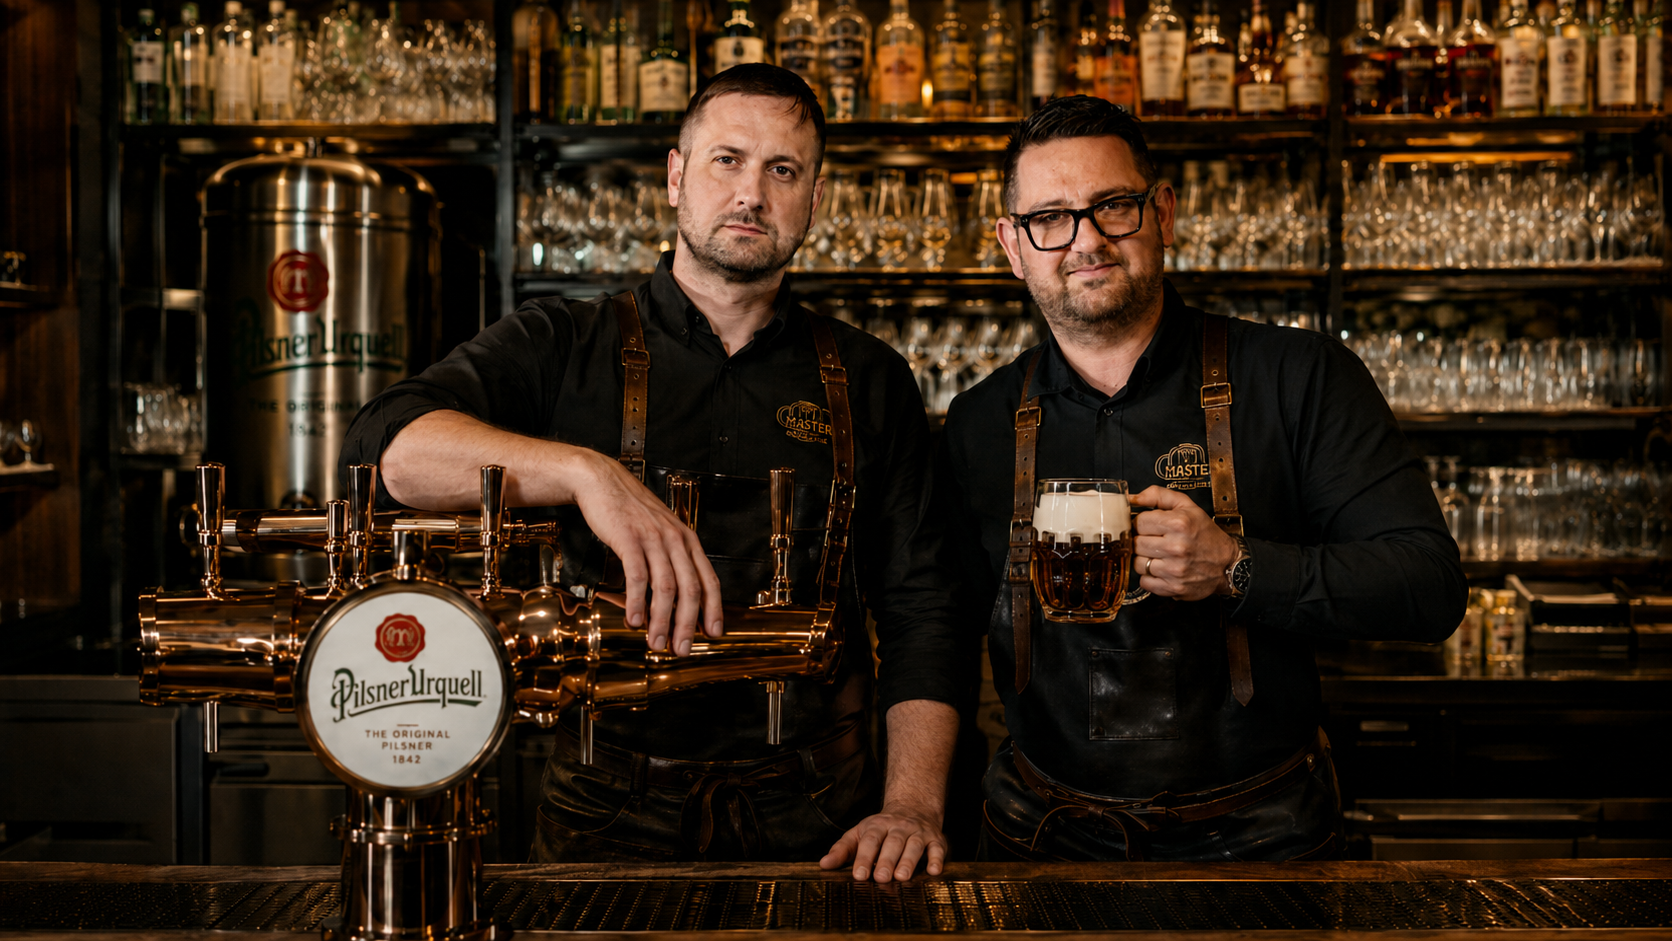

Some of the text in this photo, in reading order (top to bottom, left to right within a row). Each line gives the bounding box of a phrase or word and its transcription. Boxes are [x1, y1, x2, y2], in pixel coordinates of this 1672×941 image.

[316, 314, 404, 372] Urquell
[785, 415, 833, 436] MASTER
[1164, 463, 1210, 478] MASTE
[330, 664, 482, 723] Pilsner Urquell
[365, 729, 451, 739] THE ORIGINAL
[381, 741, 433, 750] PILSNER
[392, 754, 421, 764] 1842
